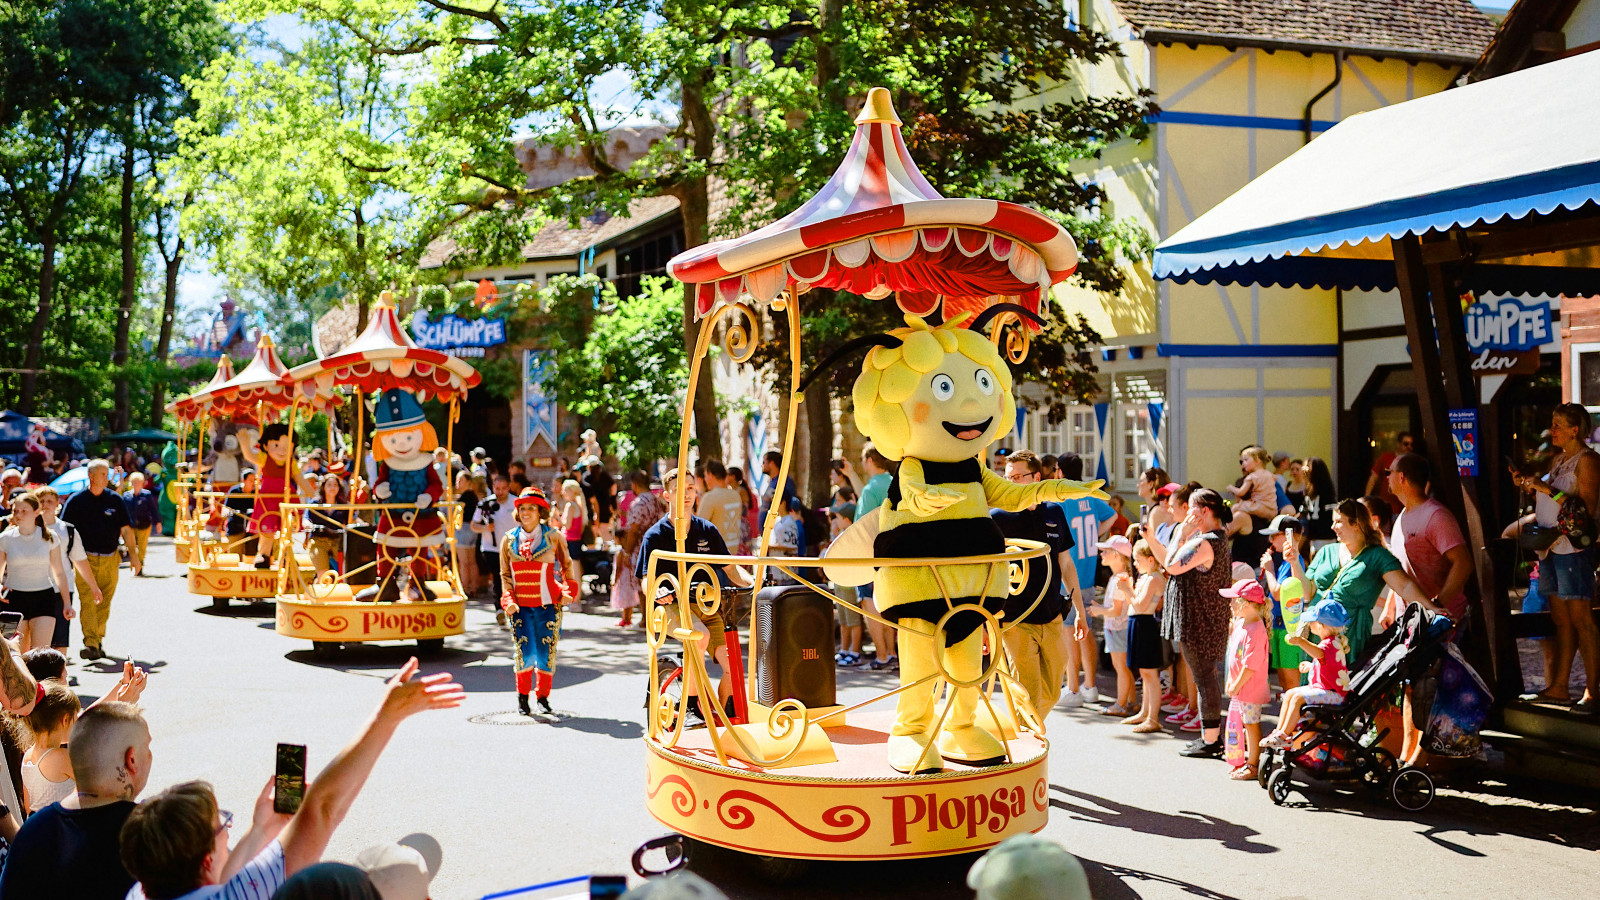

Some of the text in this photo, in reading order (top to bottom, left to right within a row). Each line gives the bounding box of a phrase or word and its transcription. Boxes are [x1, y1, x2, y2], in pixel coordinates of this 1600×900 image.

[412, 309, 503, 347] SCHLÜMPFE
[1466, 303, 1547, 348] ÜMPFE
[1471, 350, 1518, 371] den
[1078, 499, 1092, 512] HILL
[1071, 514, 1099, 559] 10
[360, 611, 436, 634] Plopsa
[802, 648, 820, 660] JBL
[882, 785, 1027, 847] Plopsa
